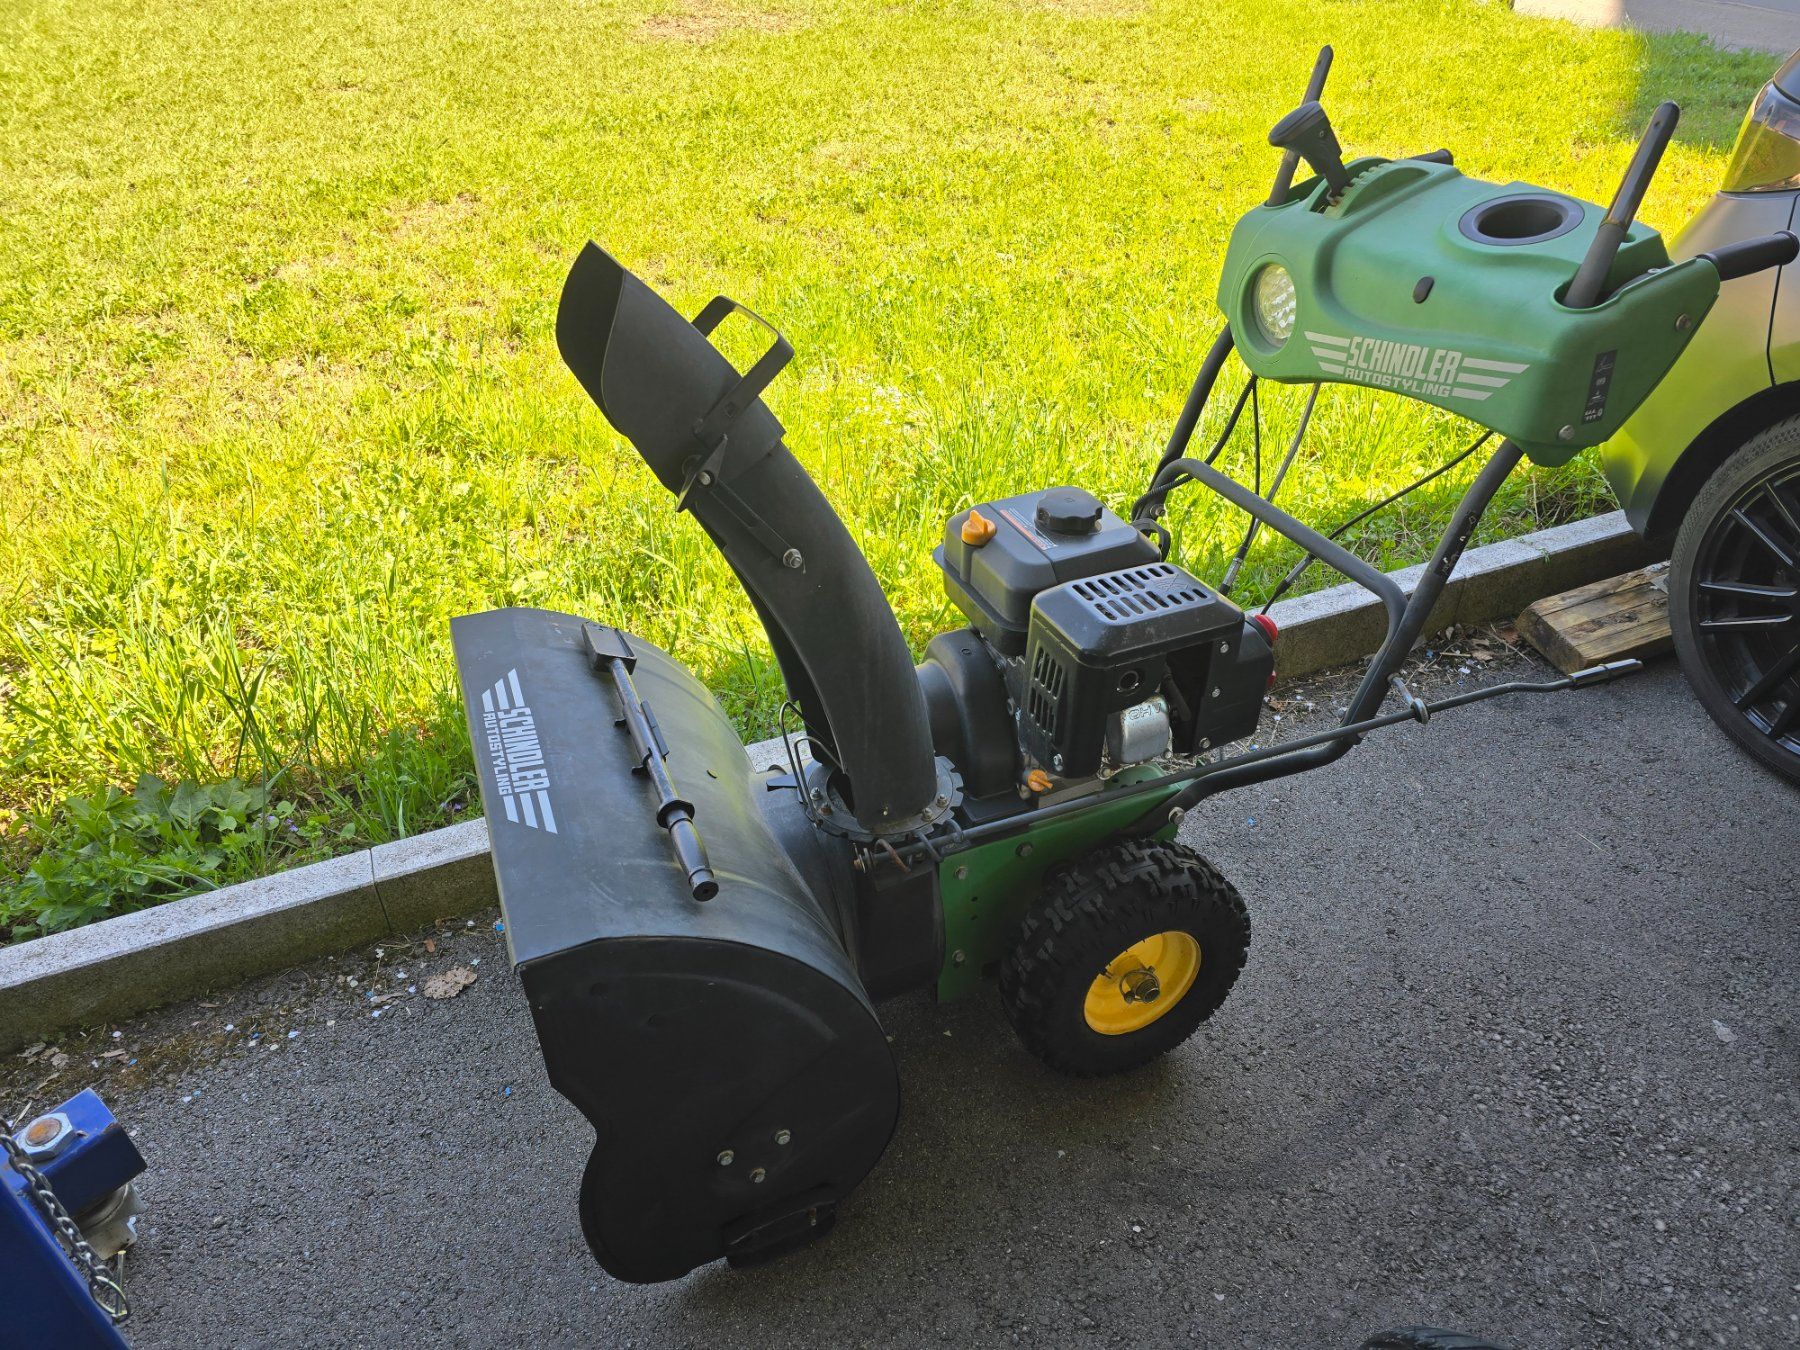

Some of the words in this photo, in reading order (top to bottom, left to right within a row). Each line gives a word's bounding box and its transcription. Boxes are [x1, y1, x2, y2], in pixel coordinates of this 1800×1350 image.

[1345, 368, 1451, 397] AUTOSTYLING
[1348, 337, 1462, 383] SCHINDLER
[484, 712, 512, 794] AUTOSTYLING
[498, 706, 550, 793] SCHINDLER
